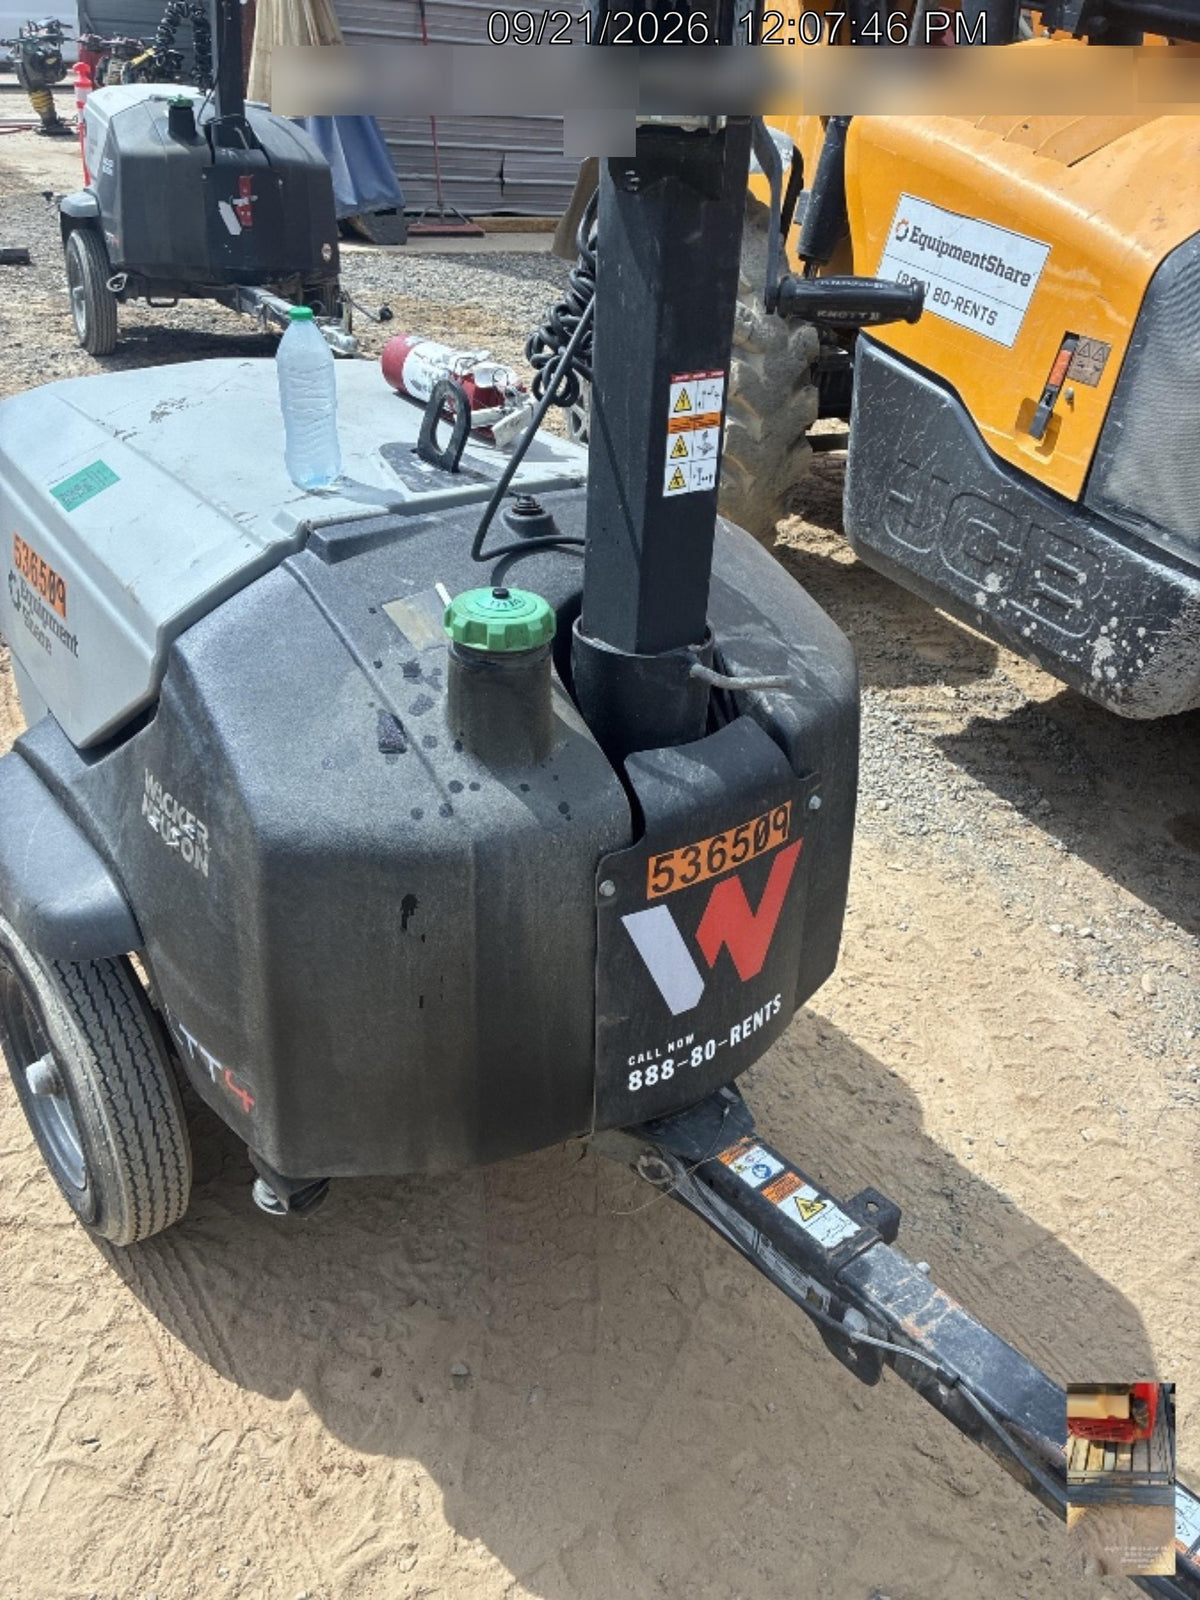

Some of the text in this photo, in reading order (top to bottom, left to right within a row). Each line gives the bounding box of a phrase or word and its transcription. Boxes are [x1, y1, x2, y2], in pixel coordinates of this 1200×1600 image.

[908, 224, 1032, 288] EquipmentShare
[932, 286, 999, 327] 80-RENTS
[14, 533, 67, 619] 536509
[881, 457, 1104, 639] JCB
[20, 574, 79, 659] Equipment
[144, 766, 209, 854] WACKER
[651, 804, 789, 894] 536509
[627, 993, 782, 1092] 888-80-RENTS
[628, 1031, 695, 1067] CALL NOW
